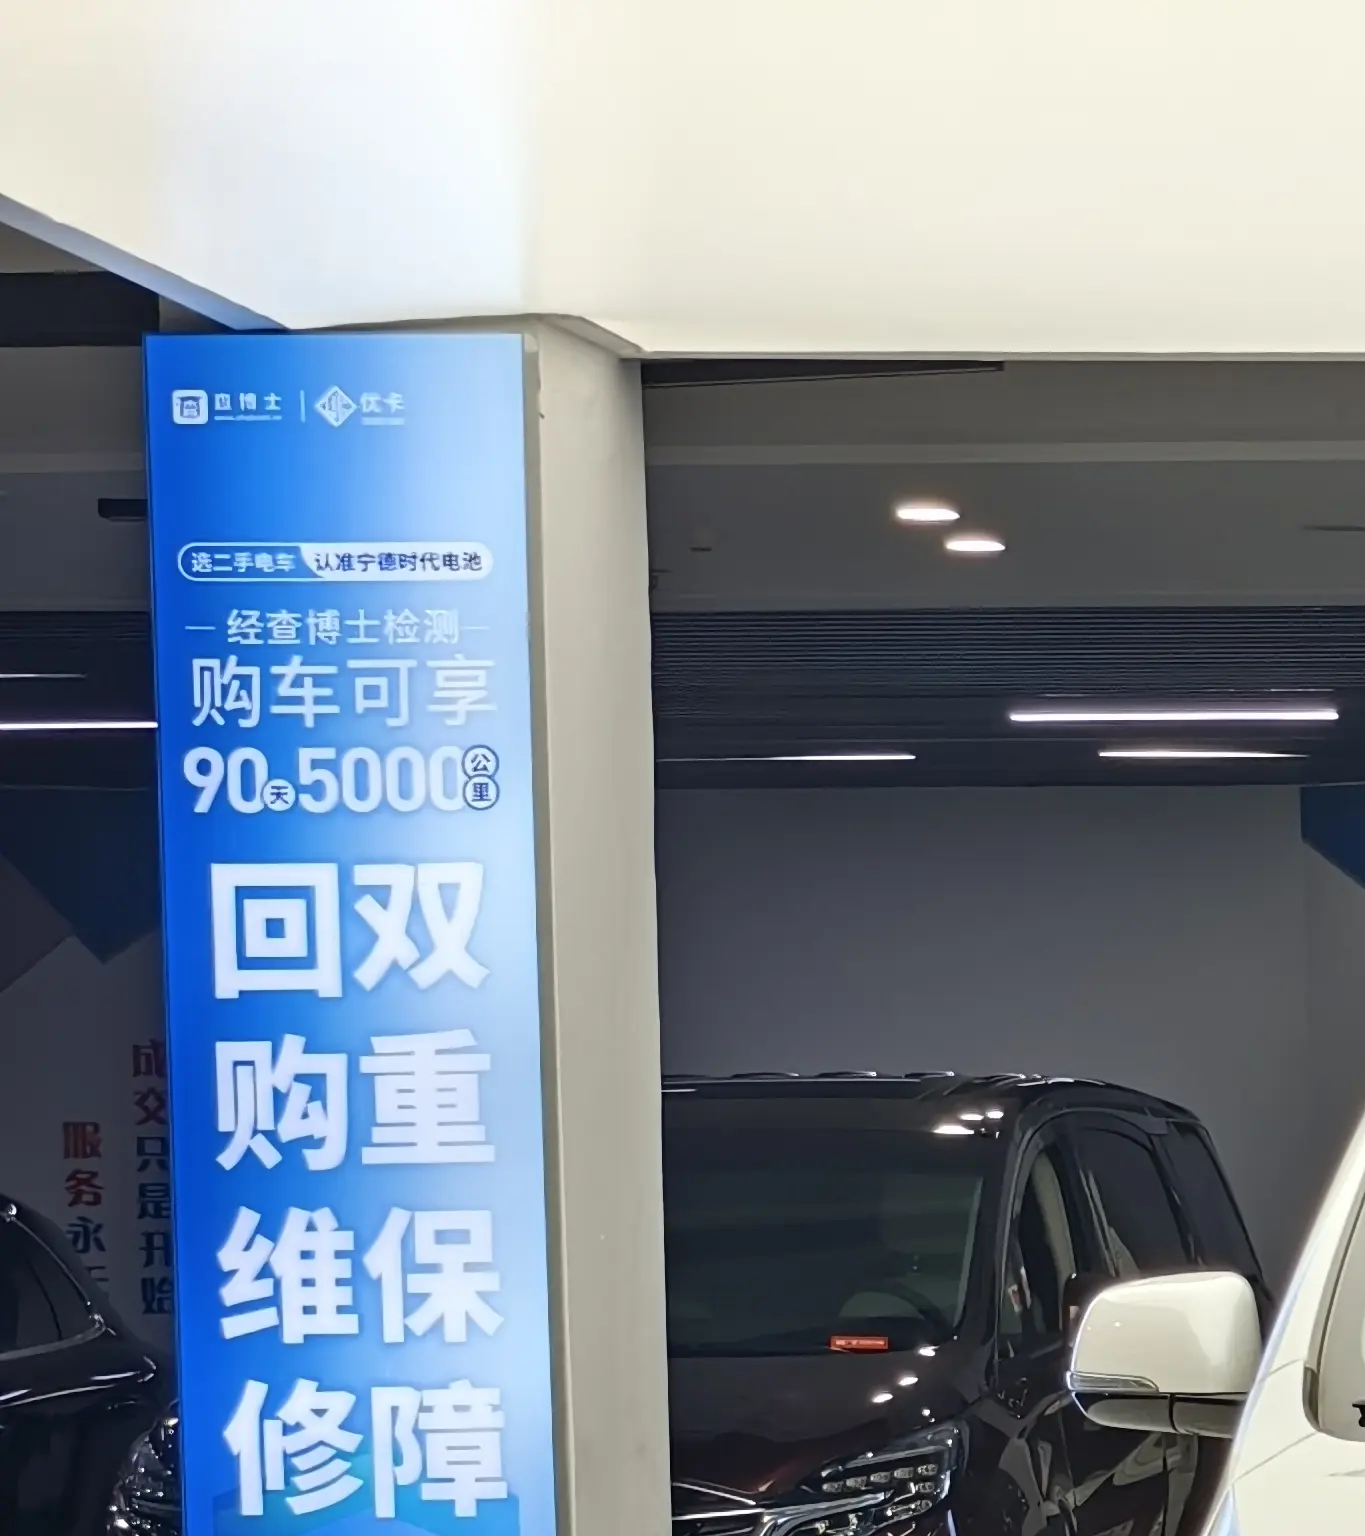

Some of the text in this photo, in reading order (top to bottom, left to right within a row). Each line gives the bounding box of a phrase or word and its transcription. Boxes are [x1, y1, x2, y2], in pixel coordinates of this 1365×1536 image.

[192, 551, 483, 573] 选二手电车 认准宁德时代电池
[227, 609, 460, 645] 经查博士检测
[192, 654, 497, 728] 购车可享
